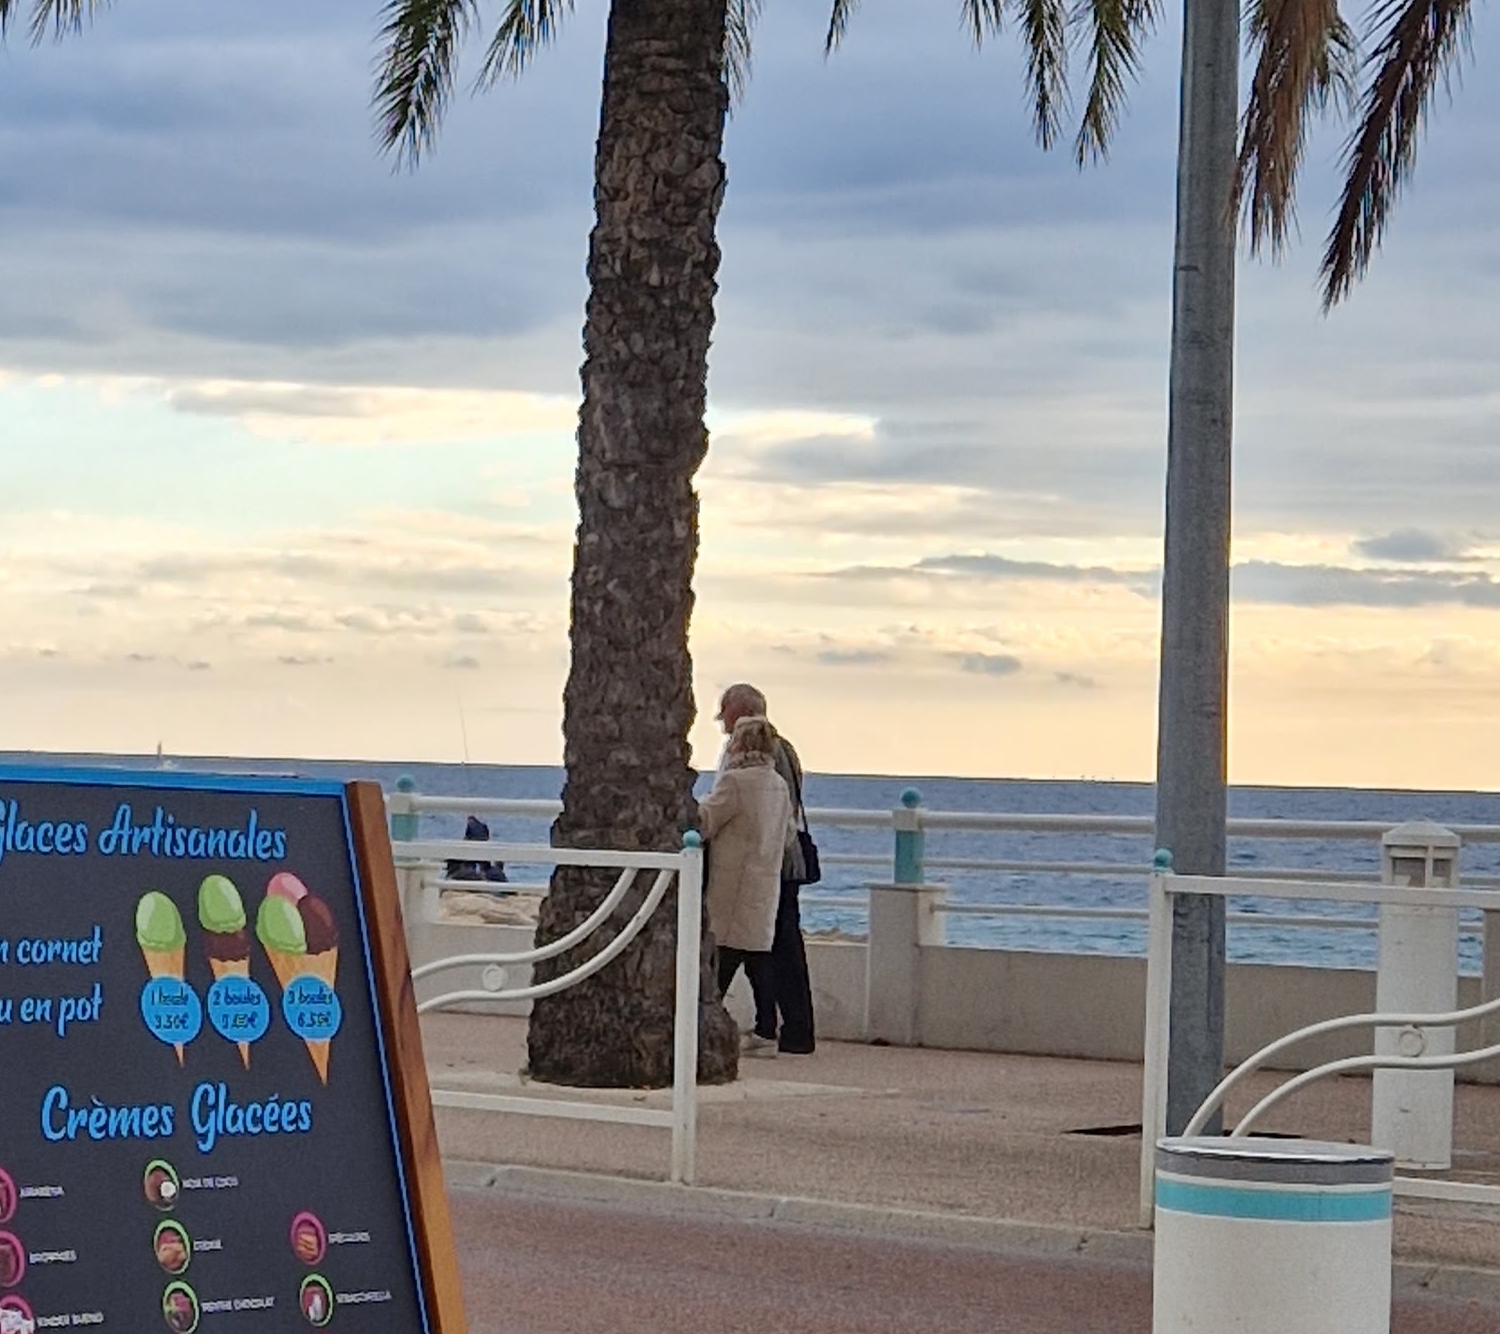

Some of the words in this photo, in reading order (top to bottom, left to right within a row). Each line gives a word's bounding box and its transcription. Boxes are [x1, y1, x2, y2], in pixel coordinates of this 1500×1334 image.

[98, 803, 287, 860] Artisanales
[16, 925, 102, 965] cornet
[20, 994, 51, 1022] en
[58, 983, 102, 1036] pot
[40, 1085, 174, 1141] Crèmes
[191, 1083, 312, 1153] Glacées
